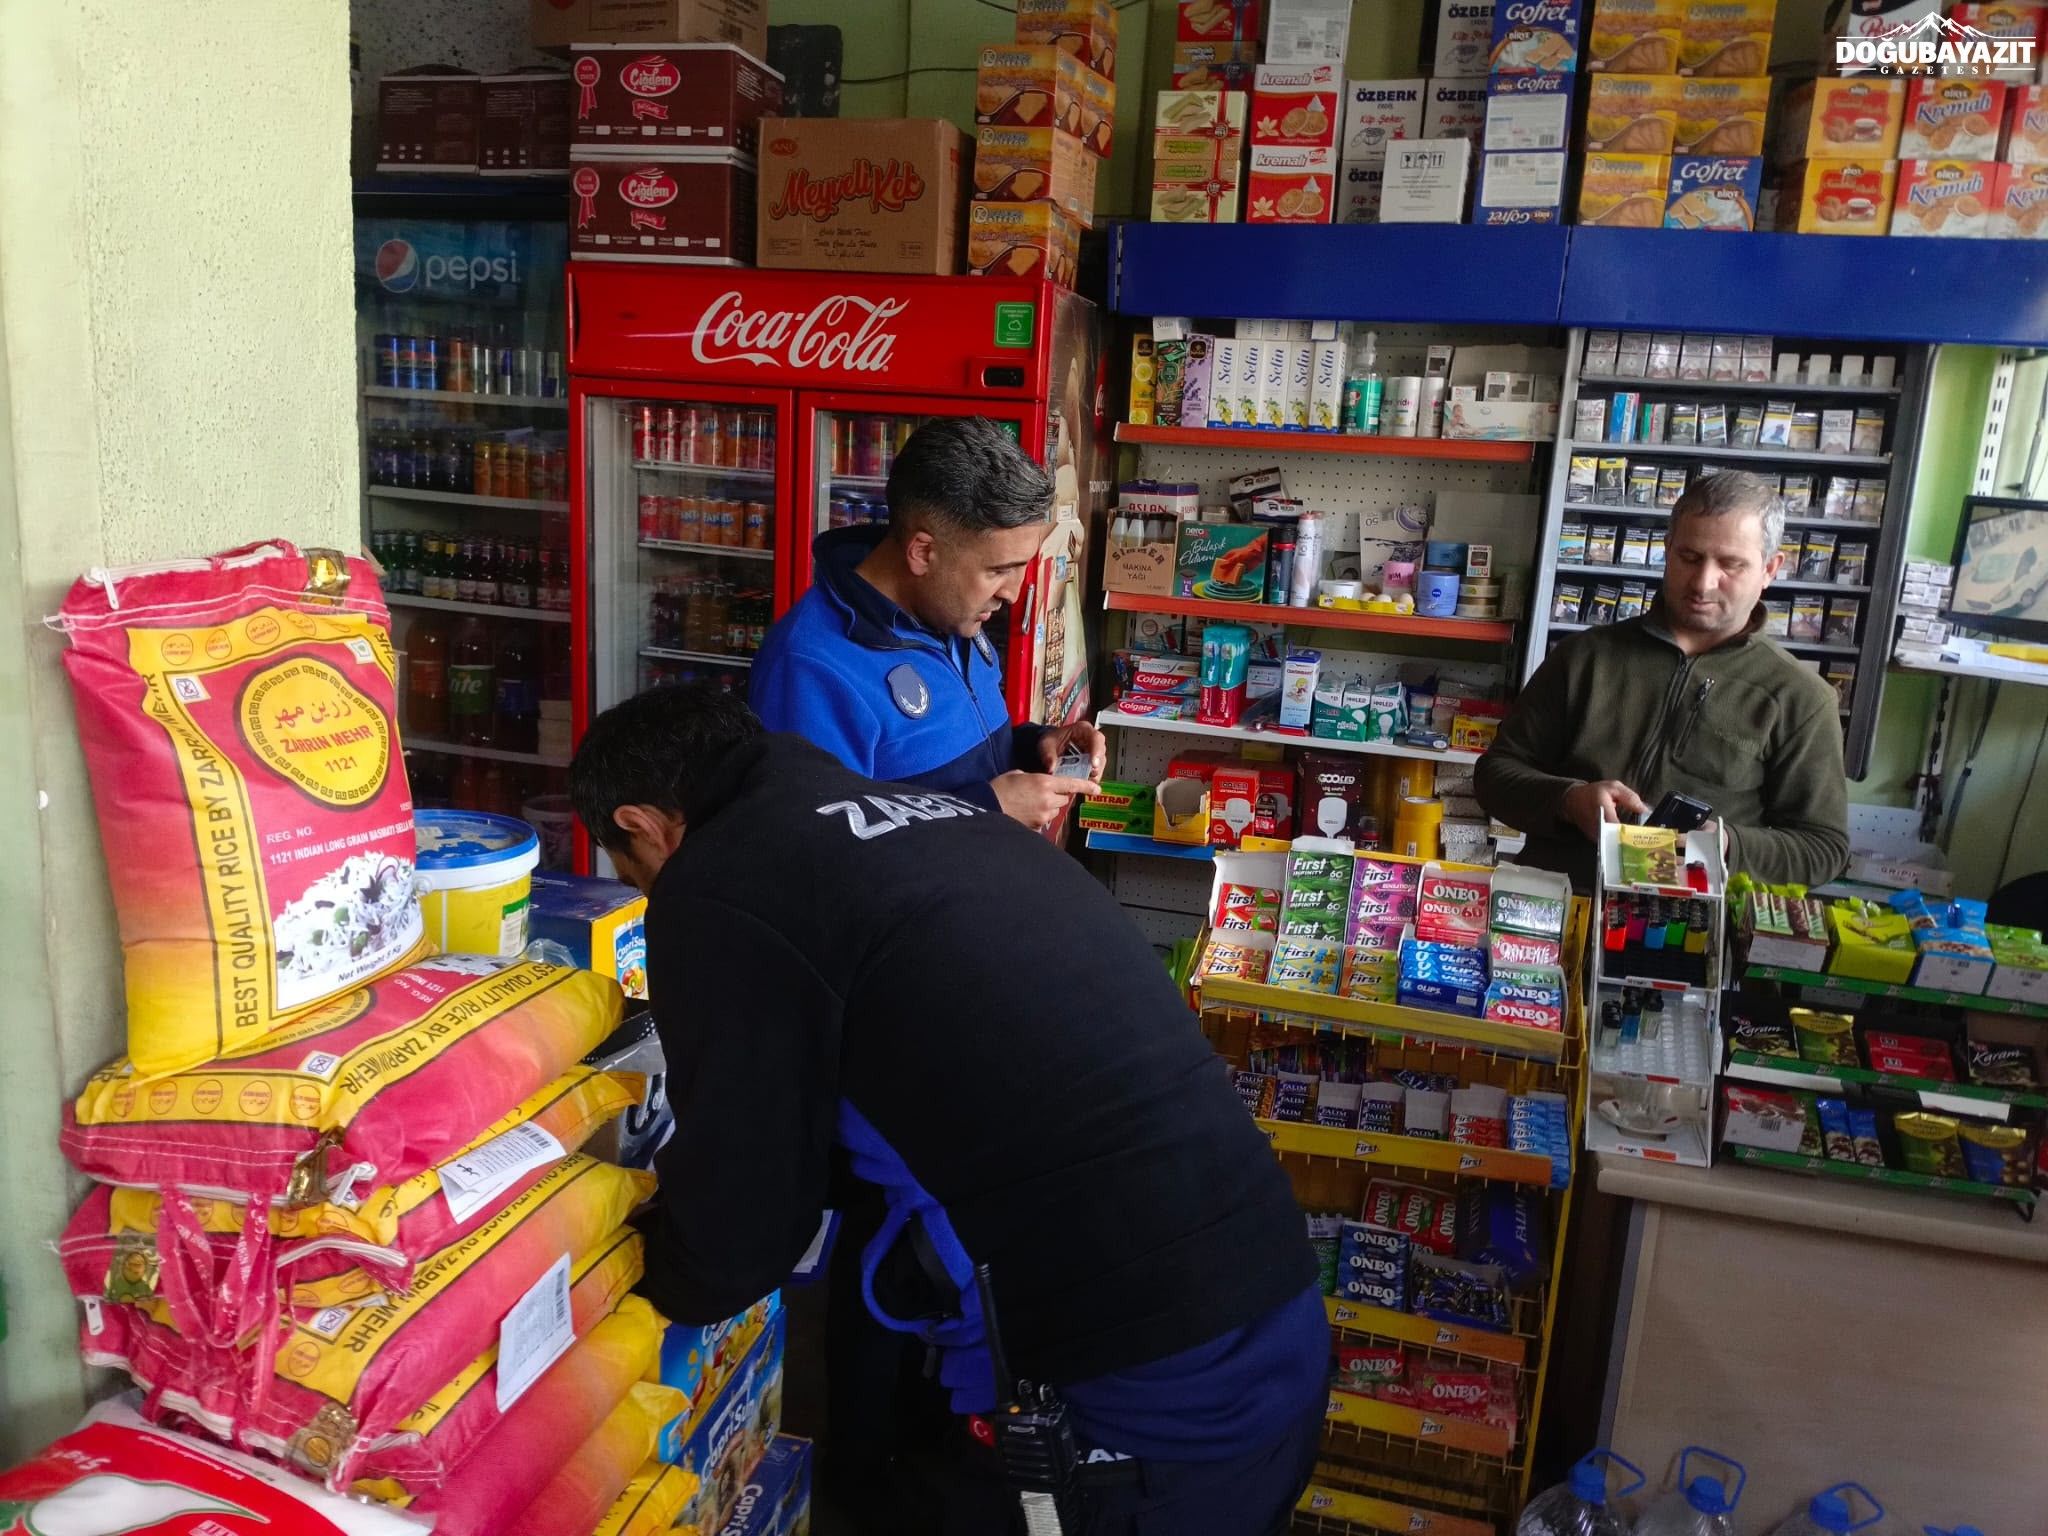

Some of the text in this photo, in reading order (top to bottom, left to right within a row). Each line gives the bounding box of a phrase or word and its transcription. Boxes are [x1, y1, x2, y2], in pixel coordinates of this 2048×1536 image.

[1448, 4, 1494, 17] ÖZBE
[1506, 3, 1571, 23] Gofret
[1517, 77, 1561, 92] Gofret
[1356, 88, 1417, 102] ÖZBERK
[1437, 88, 1487, 102] ÖZBER
[1348, 169, 1382, 183] ÖZB
[1681, 160, 1747, 183] Gofret
[769, 158, 926, 223] Meyveli Kek
[1488, 209, 1531, 224] Gofret
[425, 251, 518, 290] pepsi
[691, 290, 911, 373] Coca-Cola
[1218, 346, 1233, 384] Selin
[1243, 346, 1259, 385] Selin
[1268, 349, 1284, 387] Selin
[1294, 349, 1310, 388] Selin
[1318, 349, 1334, 388] Selin
[1136, 674, 1179, 687] Colgate
[1119, 701, 1153, 712] Colgate
[333, 725, 374, 746] MEHR
[325, 756, 357, 774] 1121
[208, 795, 233, 824] BY
[210, 826, 243, 880] RICE
[270, 853, 292, 865] 1121
[295, 843, 325, 859] INDIAN
[325, 839, 346, 852] LONG
[347, 832, 369, 847] GRAIN
[1294, 857, 1327, 871] First
[1330, 870, 1344, 879] 60
[1361, 868, 1394, 882] First
[1225, 892, 1256, 905] First
[1290, 889, 1325, 903] First
[1433, 886, 1480, 902] ONEO
[1327, 902, 1341, 911] 60
[1357, 901, 1390, 915] First
[1423, 903, 1484, 919] ONEO 60
[222, 882, 257, 971] QUALITY
[1222, 918, 1252, 930] First
[1285, 921, 1319, 936] First
[1353, 932, 1385, 947] First
[1211, 948, 1243, 959] First
[1284, 949, 1316, 959] First
[1351, 953, 1384, 964] First
[338, 969, 354, 983] Net
[356, 955, 386, 975] Weight
[1207, 963, 1240, 974] First
[1280, 969, 1312, 980] First
[1350, 974, 1382, 984] First
[481, 972, 533, 1006] QUALITY
[1500, 986, 1551, 1006] ONEO
[235, 976, 259, 1028] BEST
[447, 999, 481, 1026] RICE
[1496, 1005, 1549, 1026] ONEO
[421, 1021, 450, 1044] BY
[1374, 1190, 1391, 1224] ONEO
[1404, 1194, 1423, 1228] ONEO
[1353, 1231, 1400, 1253] ONEO
[1350, 1255, 1396, 1279] ONEO
[1347, 1281, 1395, 1305] ONEO
[1350, 1358, 1397, 1373] ONEO
[1432, 1384, 1482, 1401] ONEO
[1421, 1421, 1444, 1433] First
